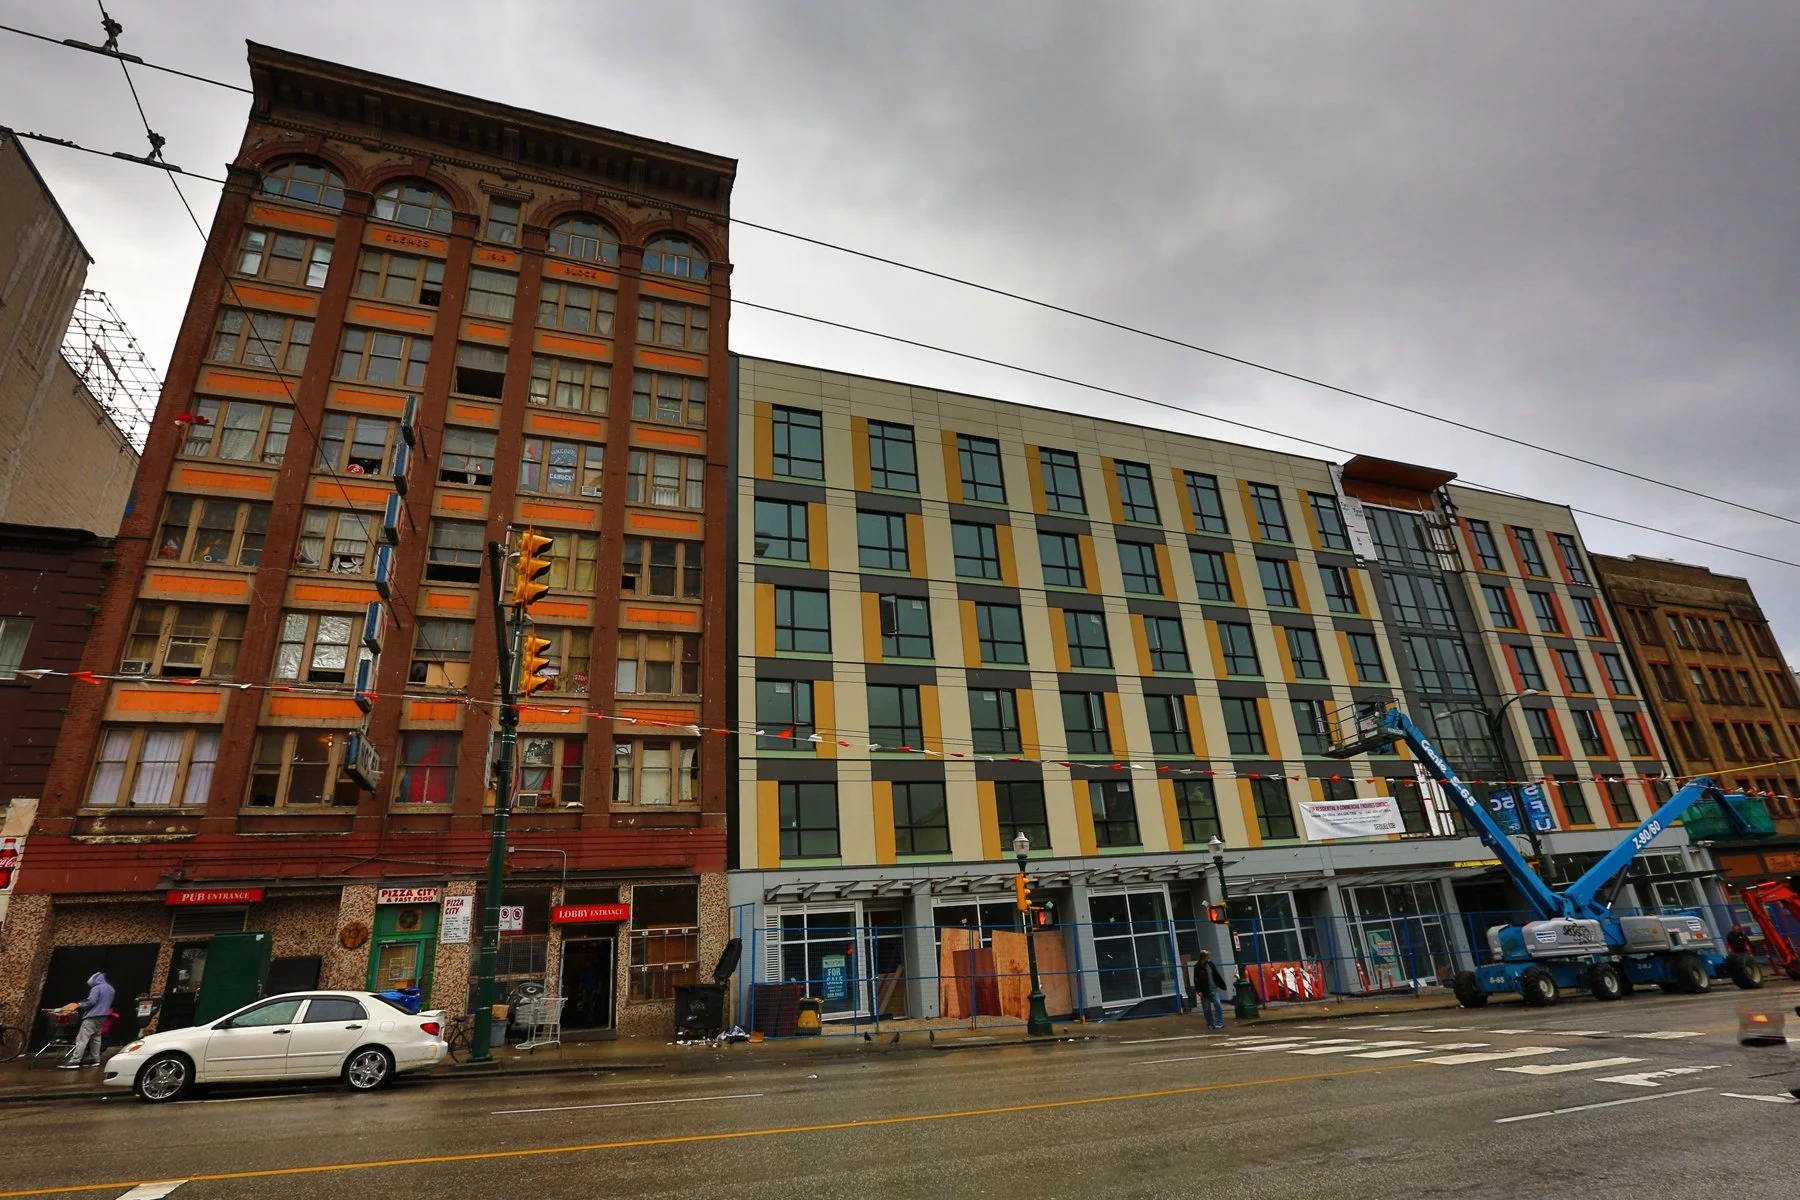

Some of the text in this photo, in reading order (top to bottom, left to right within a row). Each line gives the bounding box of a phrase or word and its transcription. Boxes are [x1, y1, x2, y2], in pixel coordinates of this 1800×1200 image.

[1450, 775, 1477, 807] S-65
[1631, 820, 1661, 850] Z-80/60
[182, 892, 250, 902] PUB ENTRANCE
[381, 888, 438, 898] PIZZA CITY
[446, 898, 464, 907] PIZZA
[445, 907, 460, 915] CITY
[559, 908, 624, 919] LOBBY ENTRANCE
[828, 967, 841, 976] FOR
[826, 976, 844, 985] SALE
